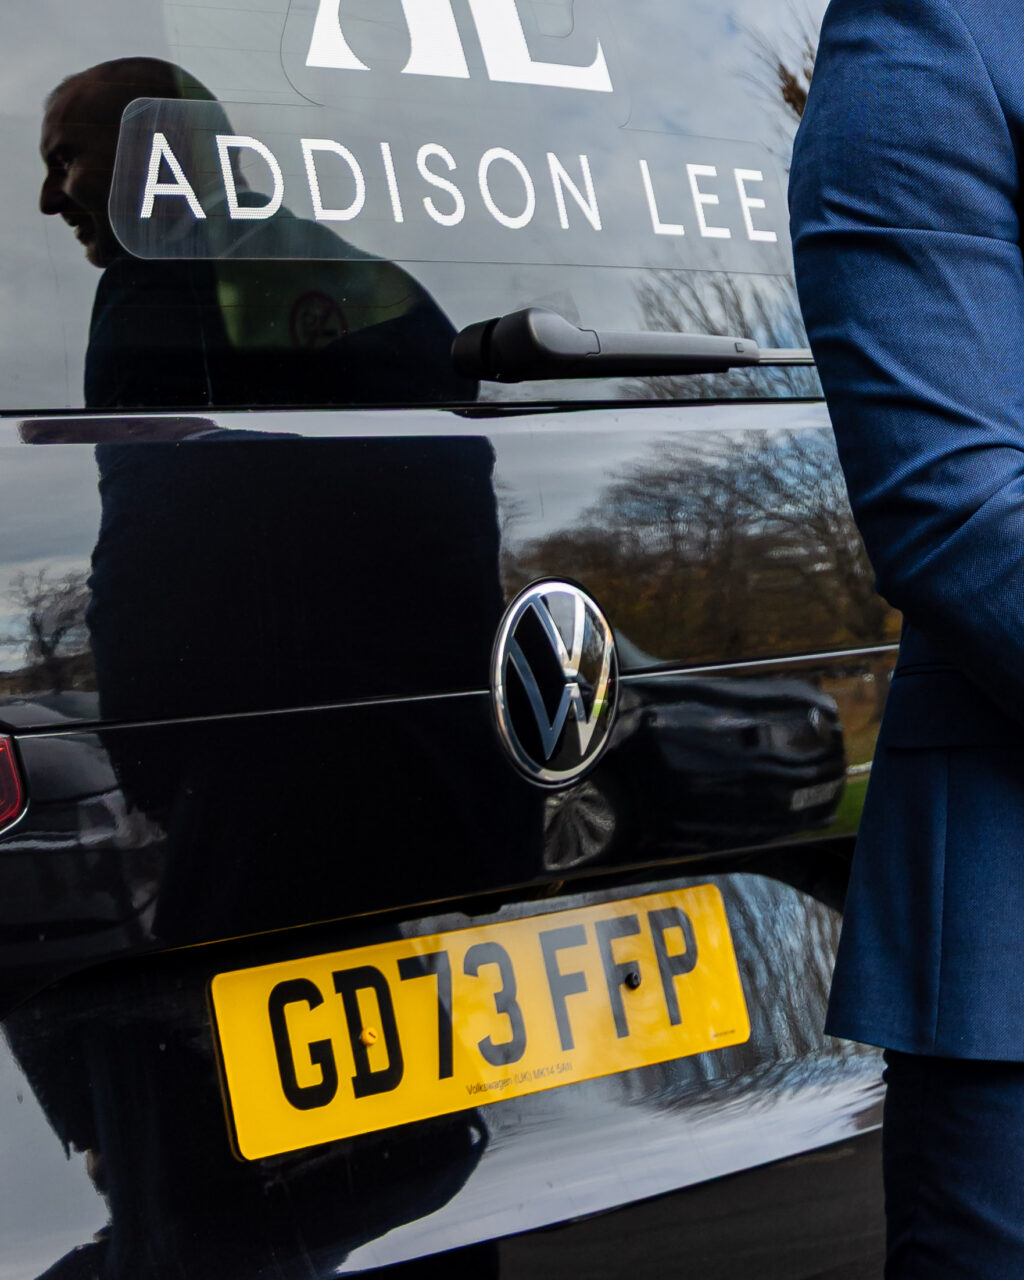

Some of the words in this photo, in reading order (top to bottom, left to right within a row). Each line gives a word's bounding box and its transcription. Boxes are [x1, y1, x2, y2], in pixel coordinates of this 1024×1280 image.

[140, 131, 603, 231] ADDISON
[639, 159, 778, 243] LEE
[267, 941, 528, 1111] GD73
[538, 906, 699, 1052] FFP
[465, 1077, 513, 1096] Volkswagen
